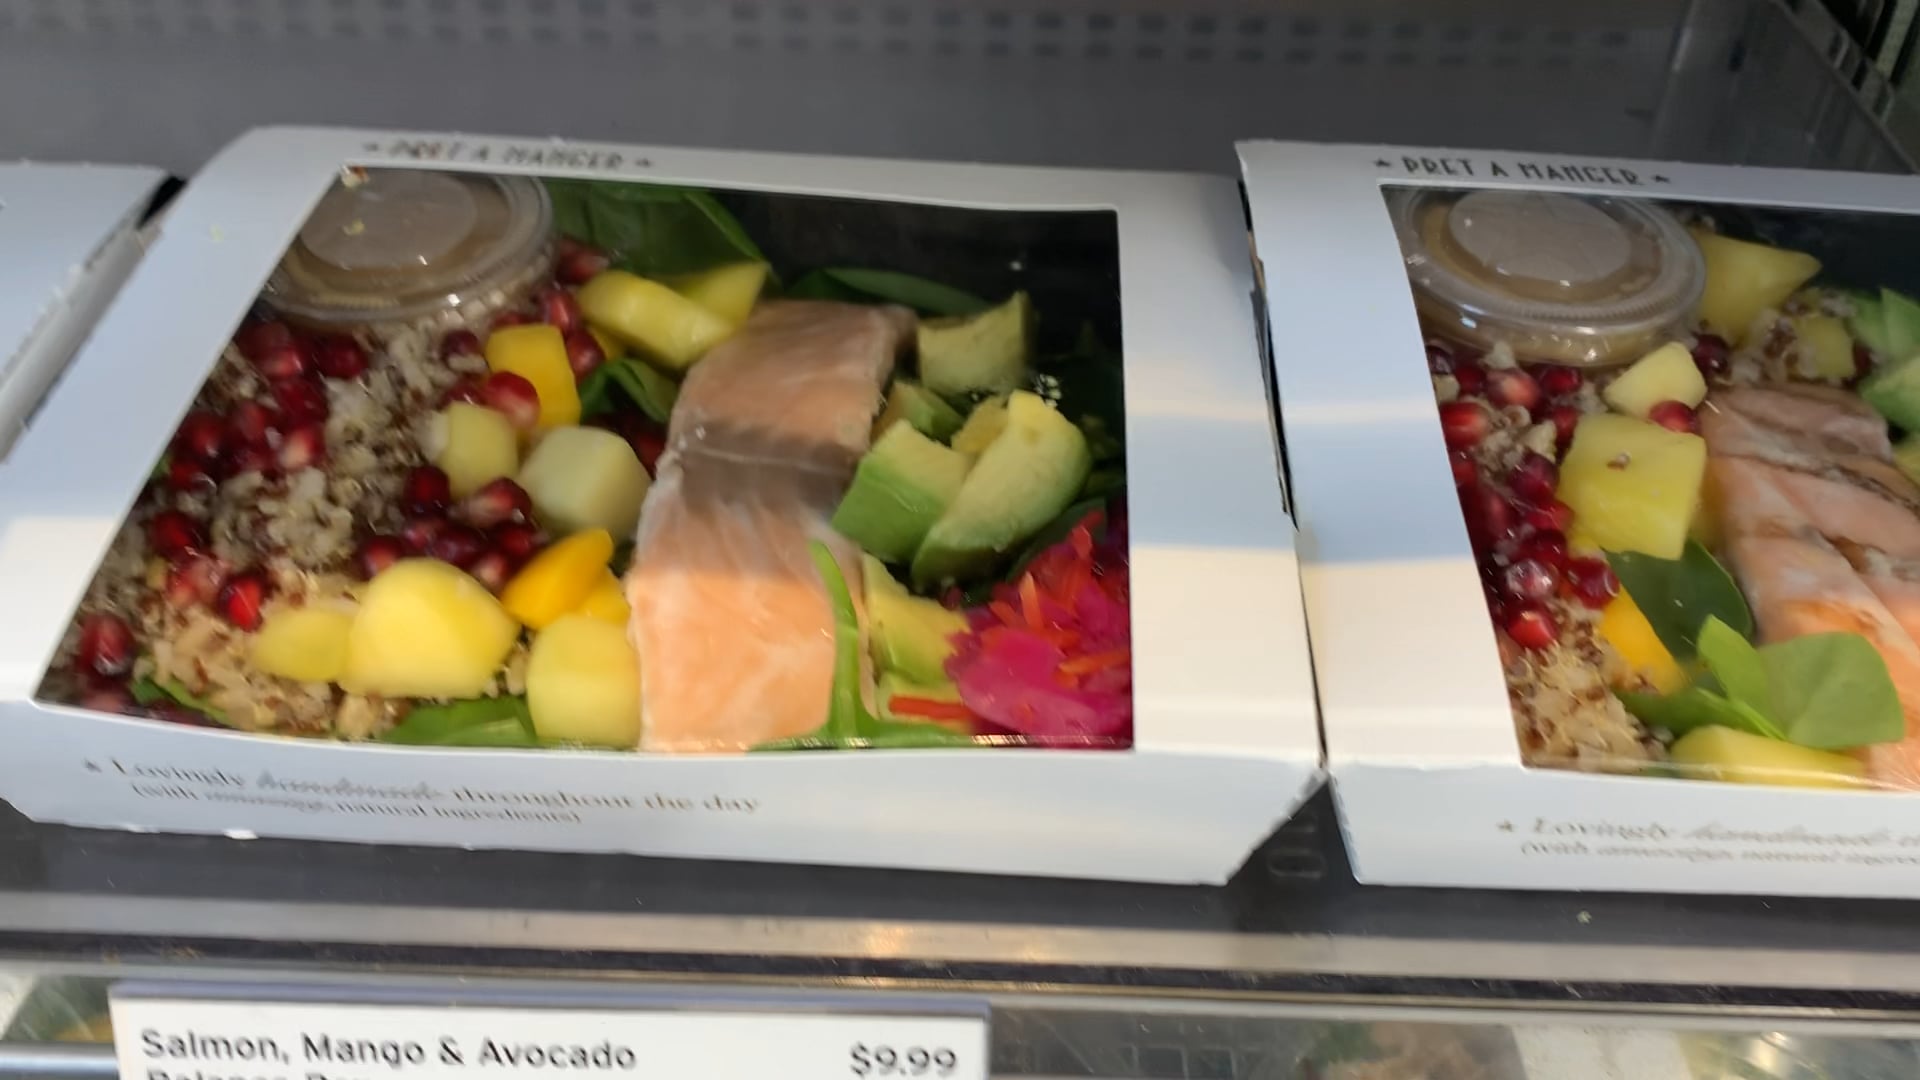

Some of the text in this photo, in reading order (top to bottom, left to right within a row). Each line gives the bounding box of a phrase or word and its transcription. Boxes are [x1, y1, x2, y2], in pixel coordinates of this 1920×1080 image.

[1402, 156, 1644, 186] PRET A MANGER
[644, 793, 692, 810] the
[703, 794, 757, 813] day
[141, 1029, 636, 1070] Salmon, Mango & Avocado
[849, 1041, 957, 1079] $9.99
